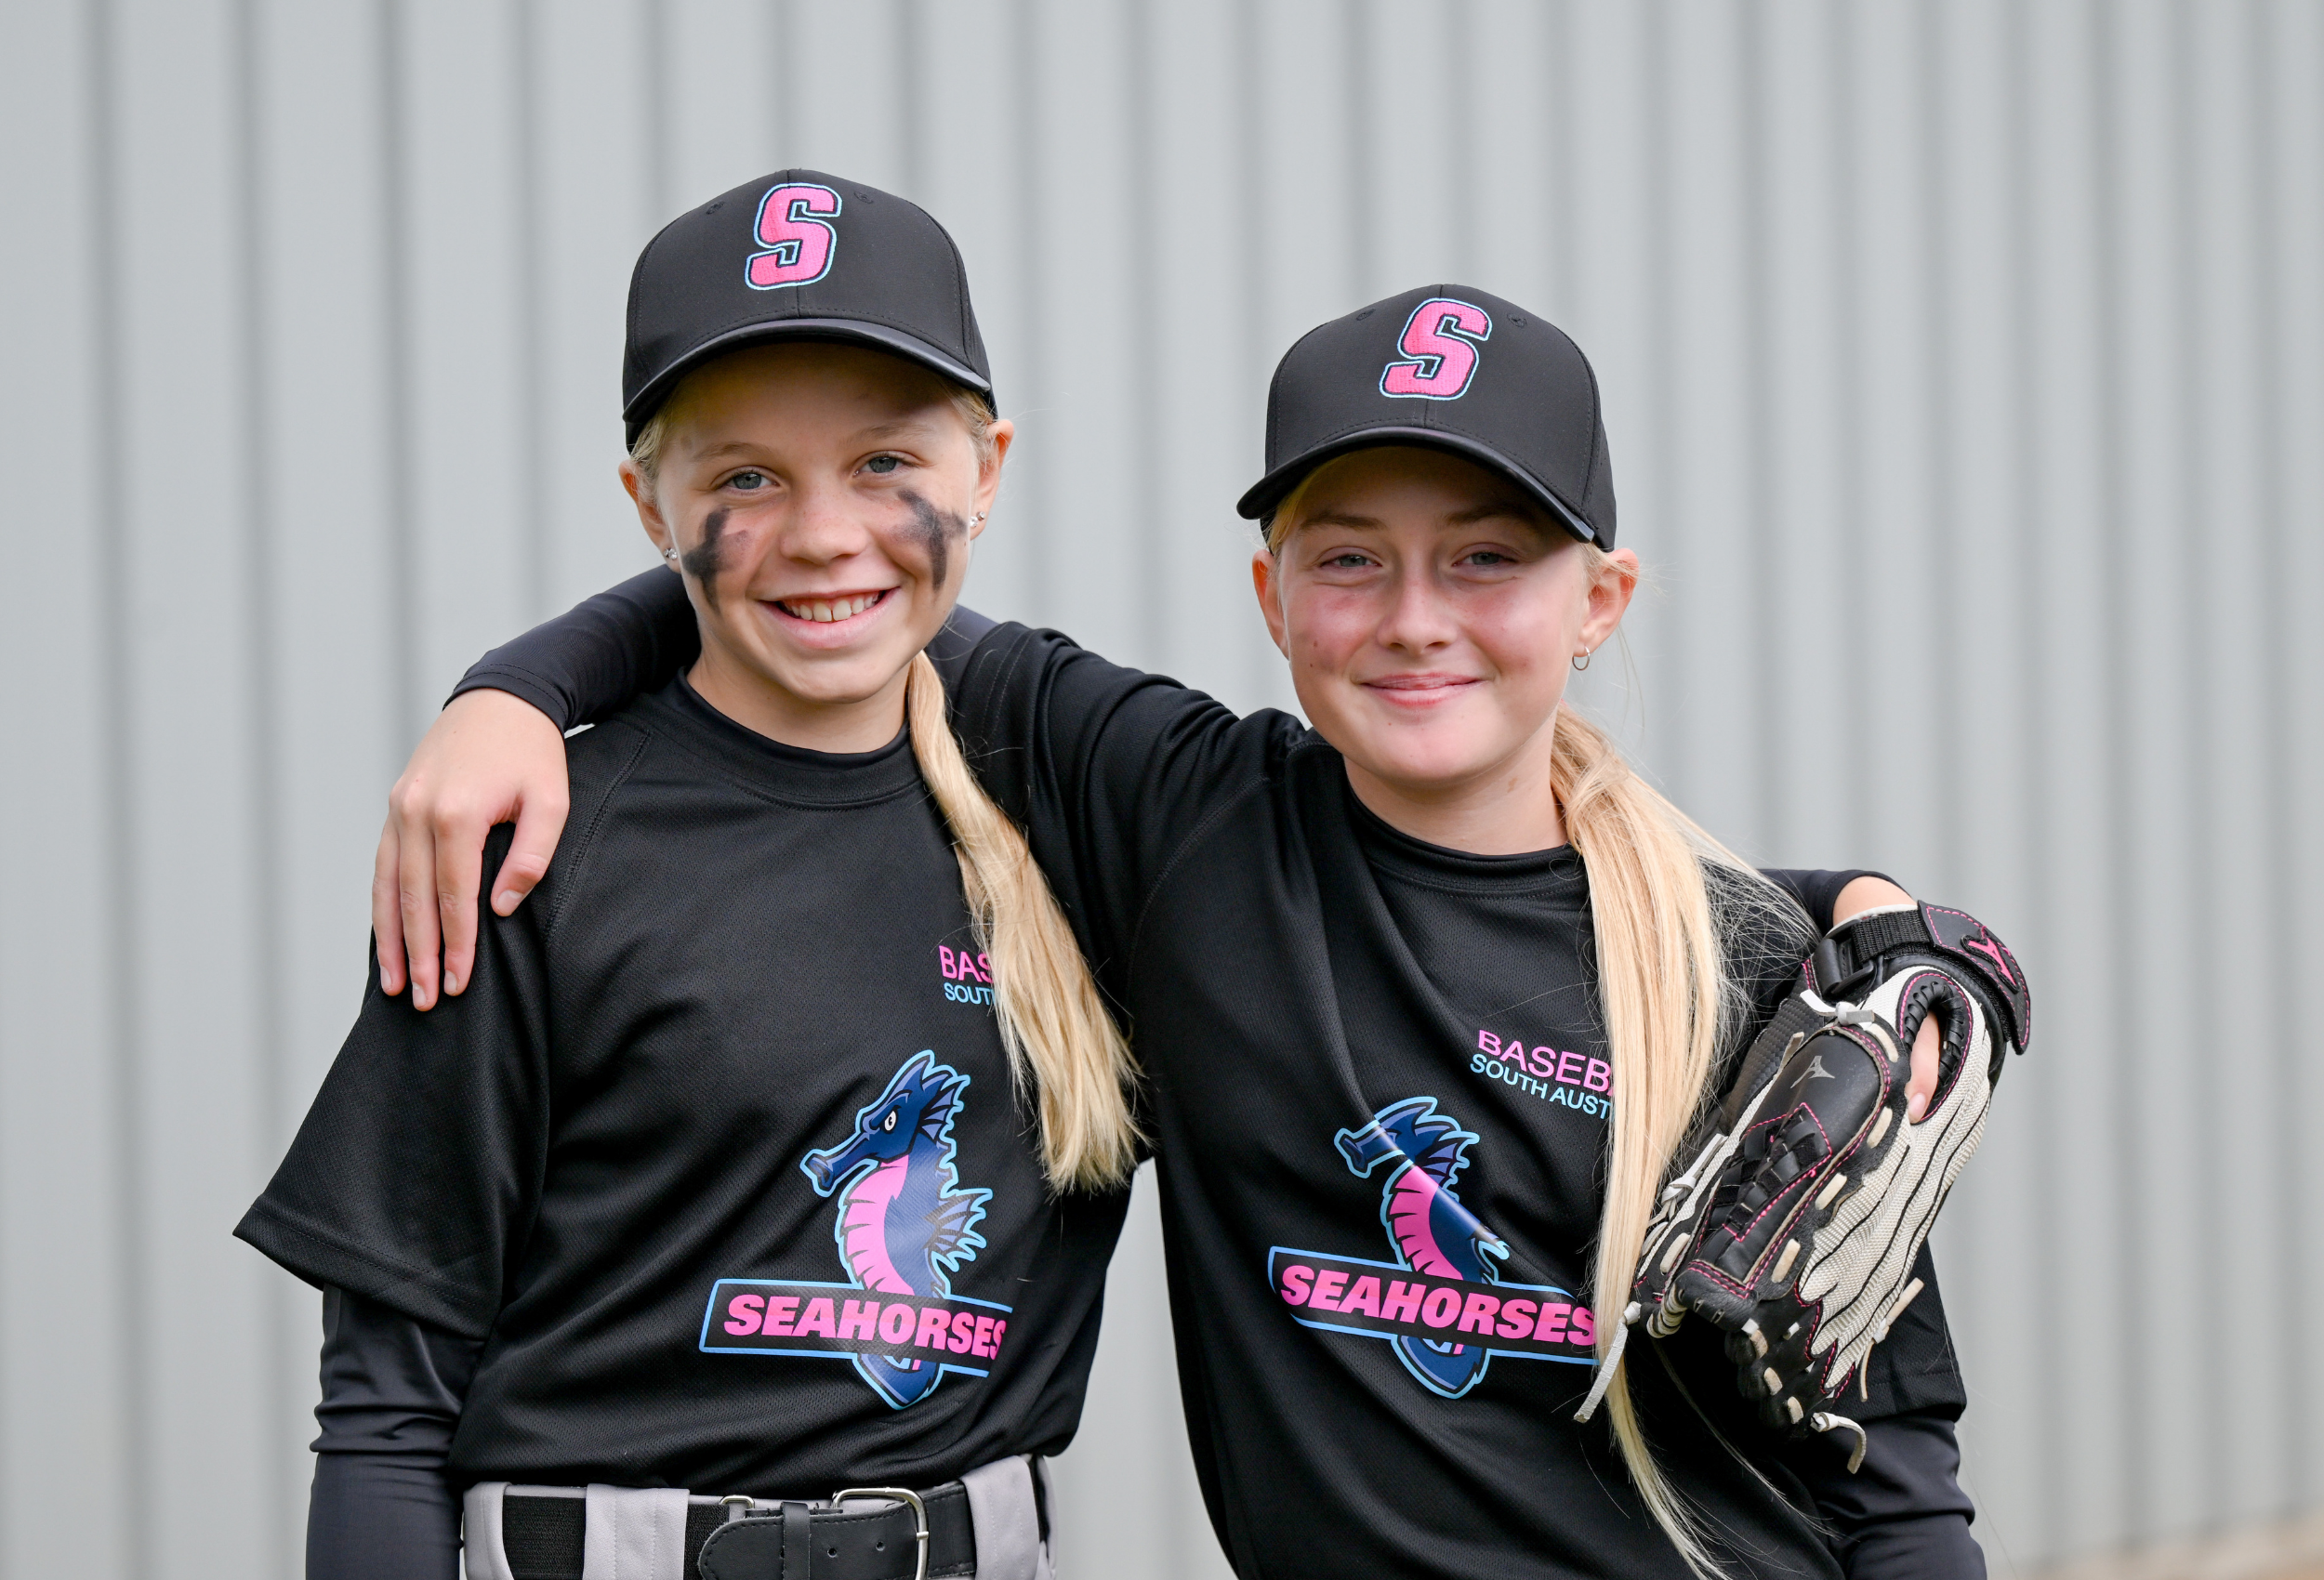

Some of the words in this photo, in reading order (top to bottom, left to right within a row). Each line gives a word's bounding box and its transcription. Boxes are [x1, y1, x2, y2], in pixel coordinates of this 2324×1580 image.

[745, 182, 842, 290] S
[1379, 297, 1492, 400] S
[1470, 1053, 1548, 1099] SOUTH
[1549, 1086, 1614, 1121] AUST
[1478, 1030, 1614, 1097] BASEB
[723, 1294, 1007, 1360] SEAHORSES
[1280, 1265, 1595, 1346] SEAHORSES
